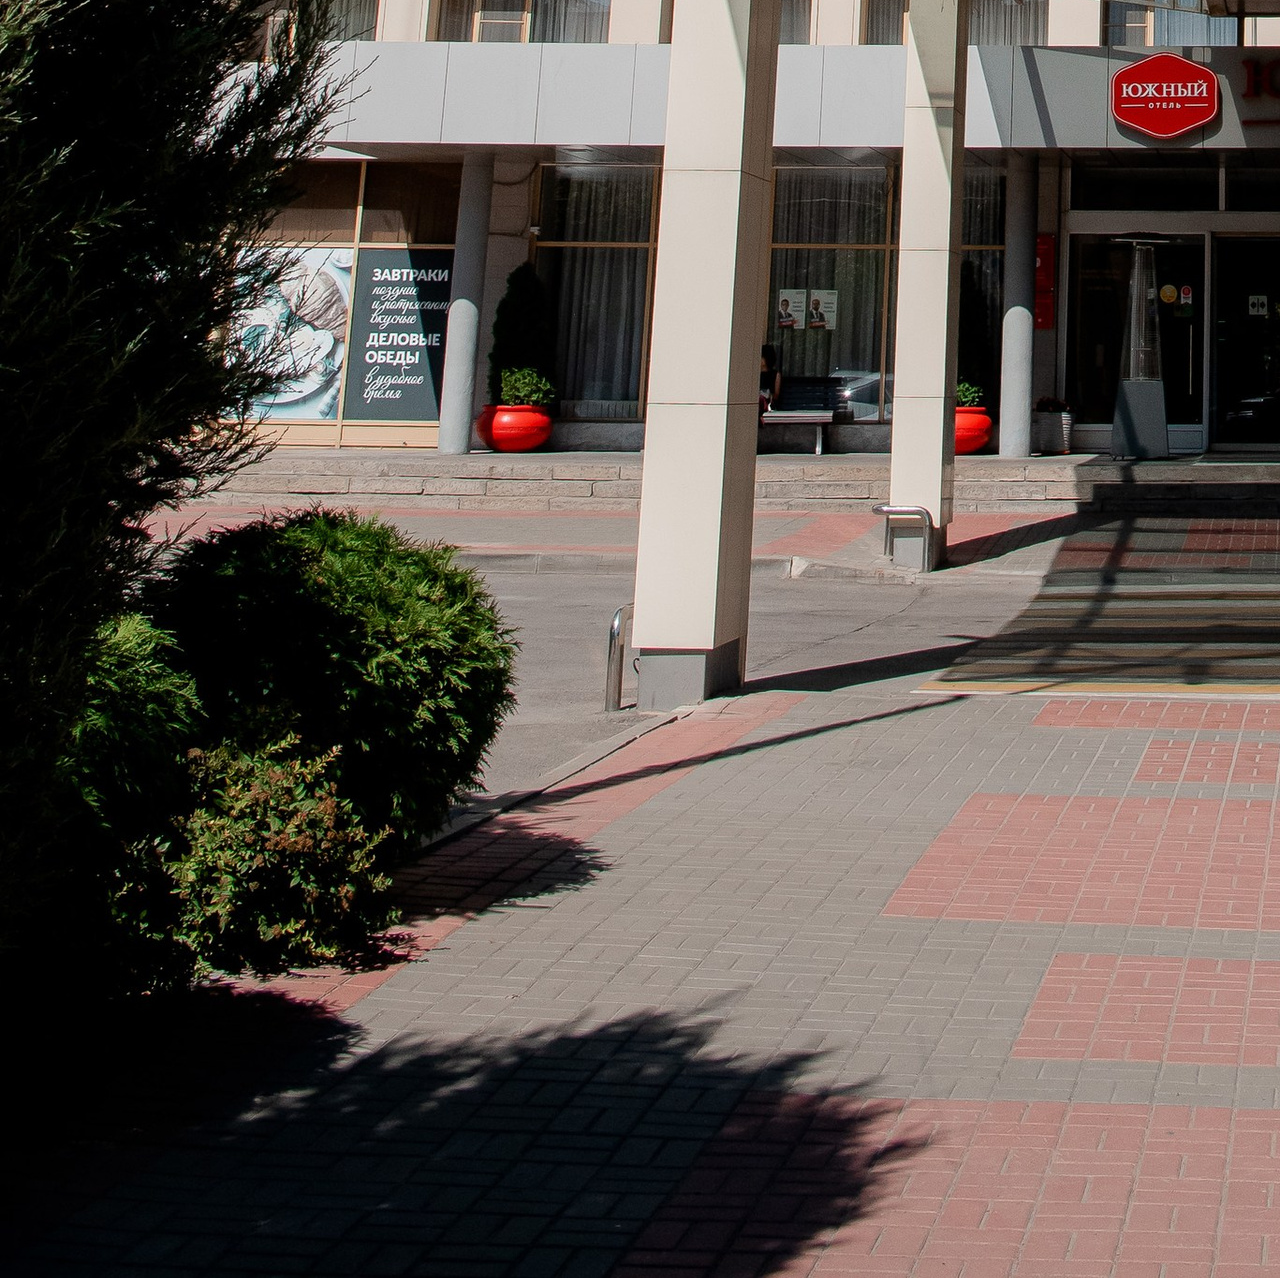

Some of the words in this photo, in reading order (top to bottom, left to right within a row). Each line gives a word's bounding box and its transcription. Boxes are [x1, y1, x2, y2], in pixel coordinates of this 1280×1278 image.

[1120, 79, 1209, 98] ЮЖНЫЙ
[1147, 102, 1182, 110] ОТЕЛЬ
[371, 268, 449, 282] ЗАВТРАКИ
[371, 285, 419, 301] поздние
[371, 300, 380, 309] и
[369, 305, 418, 330] вкусные
[365, 332, 441, 348] ДЕЛОВЫЕ
[364, 350, 420, 366] ОБЕДЫ
[364, 365, 380, 384] в
[376, 365, 425, 390] удобное
[363, 380, 403, 404] время
